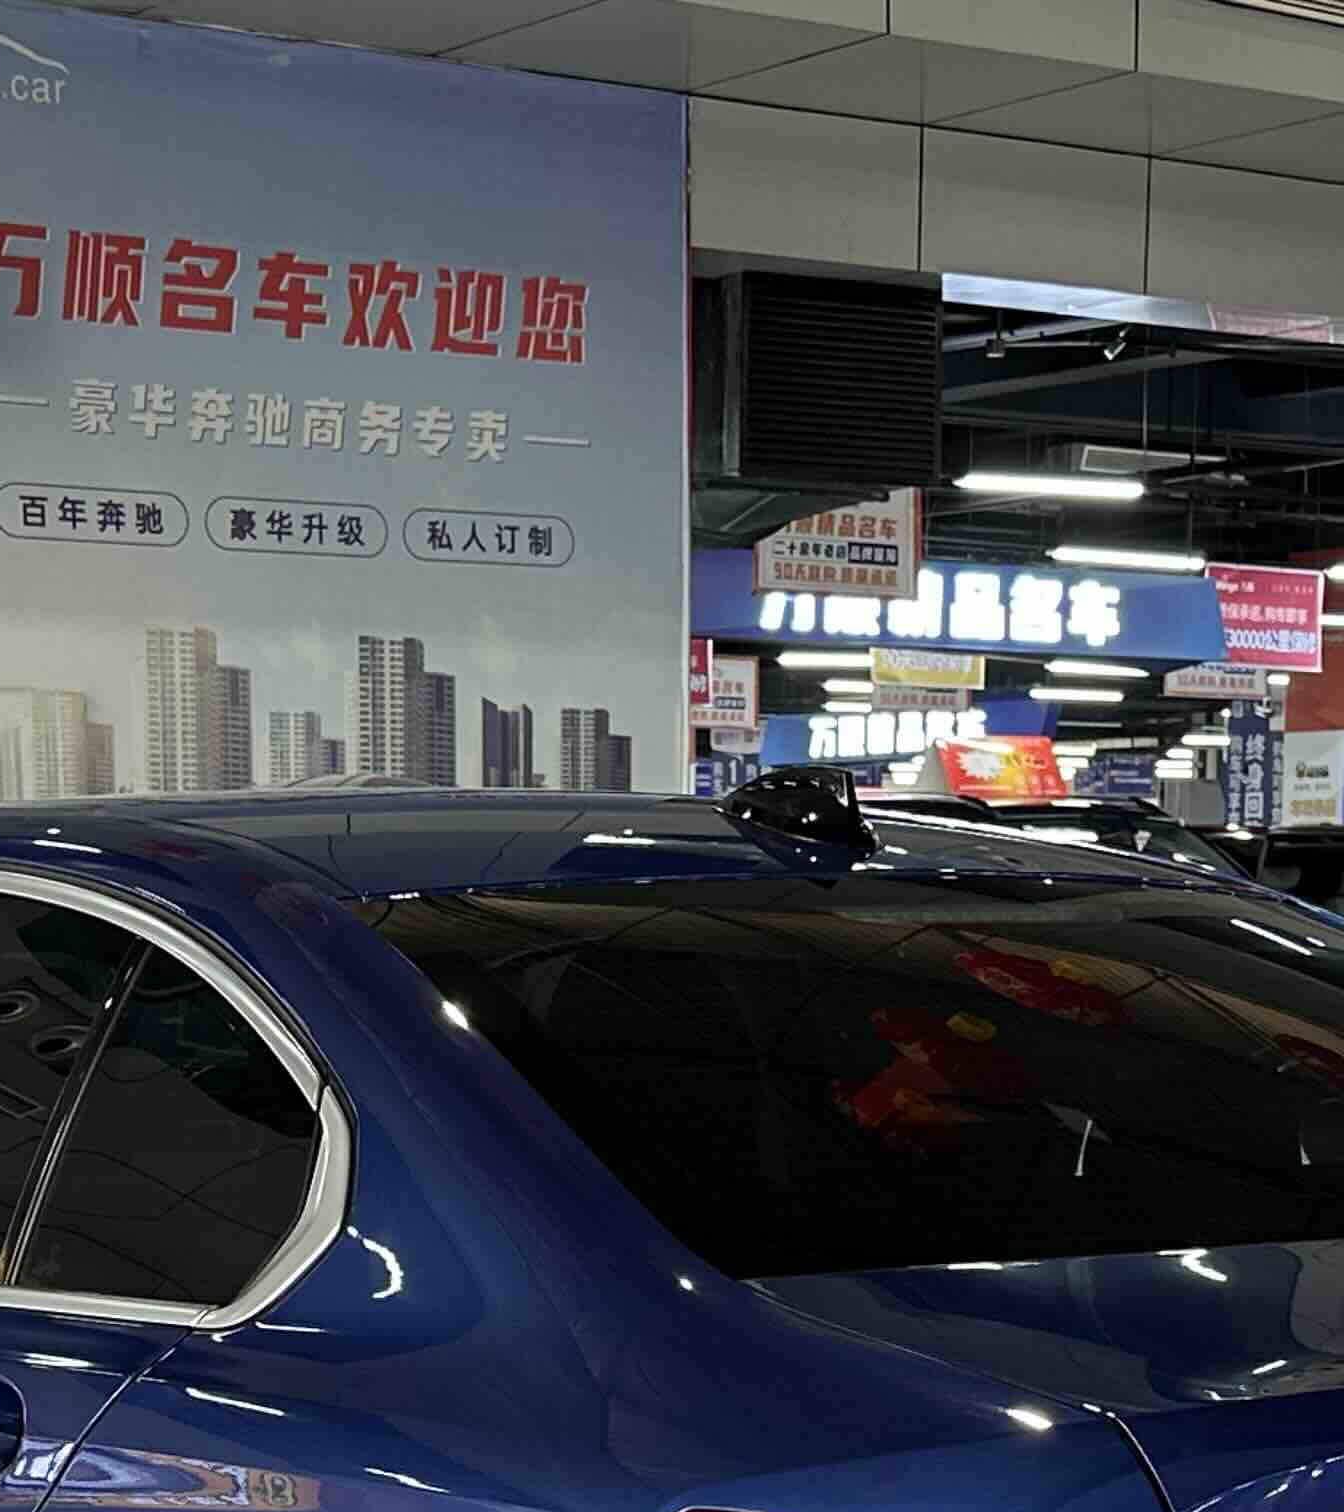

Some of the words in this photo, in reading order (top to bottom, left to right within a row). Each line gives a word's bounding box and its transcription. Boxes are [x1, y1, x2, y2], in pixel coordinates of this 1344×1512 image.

[68, 378, 511, 465] 豪华奔驰商务专卖
[19, 494, 166, 538] 百年奔驰
[228, 507, 368, 550] 豪华升级
[426, 521, 555, 560] 私人订制
